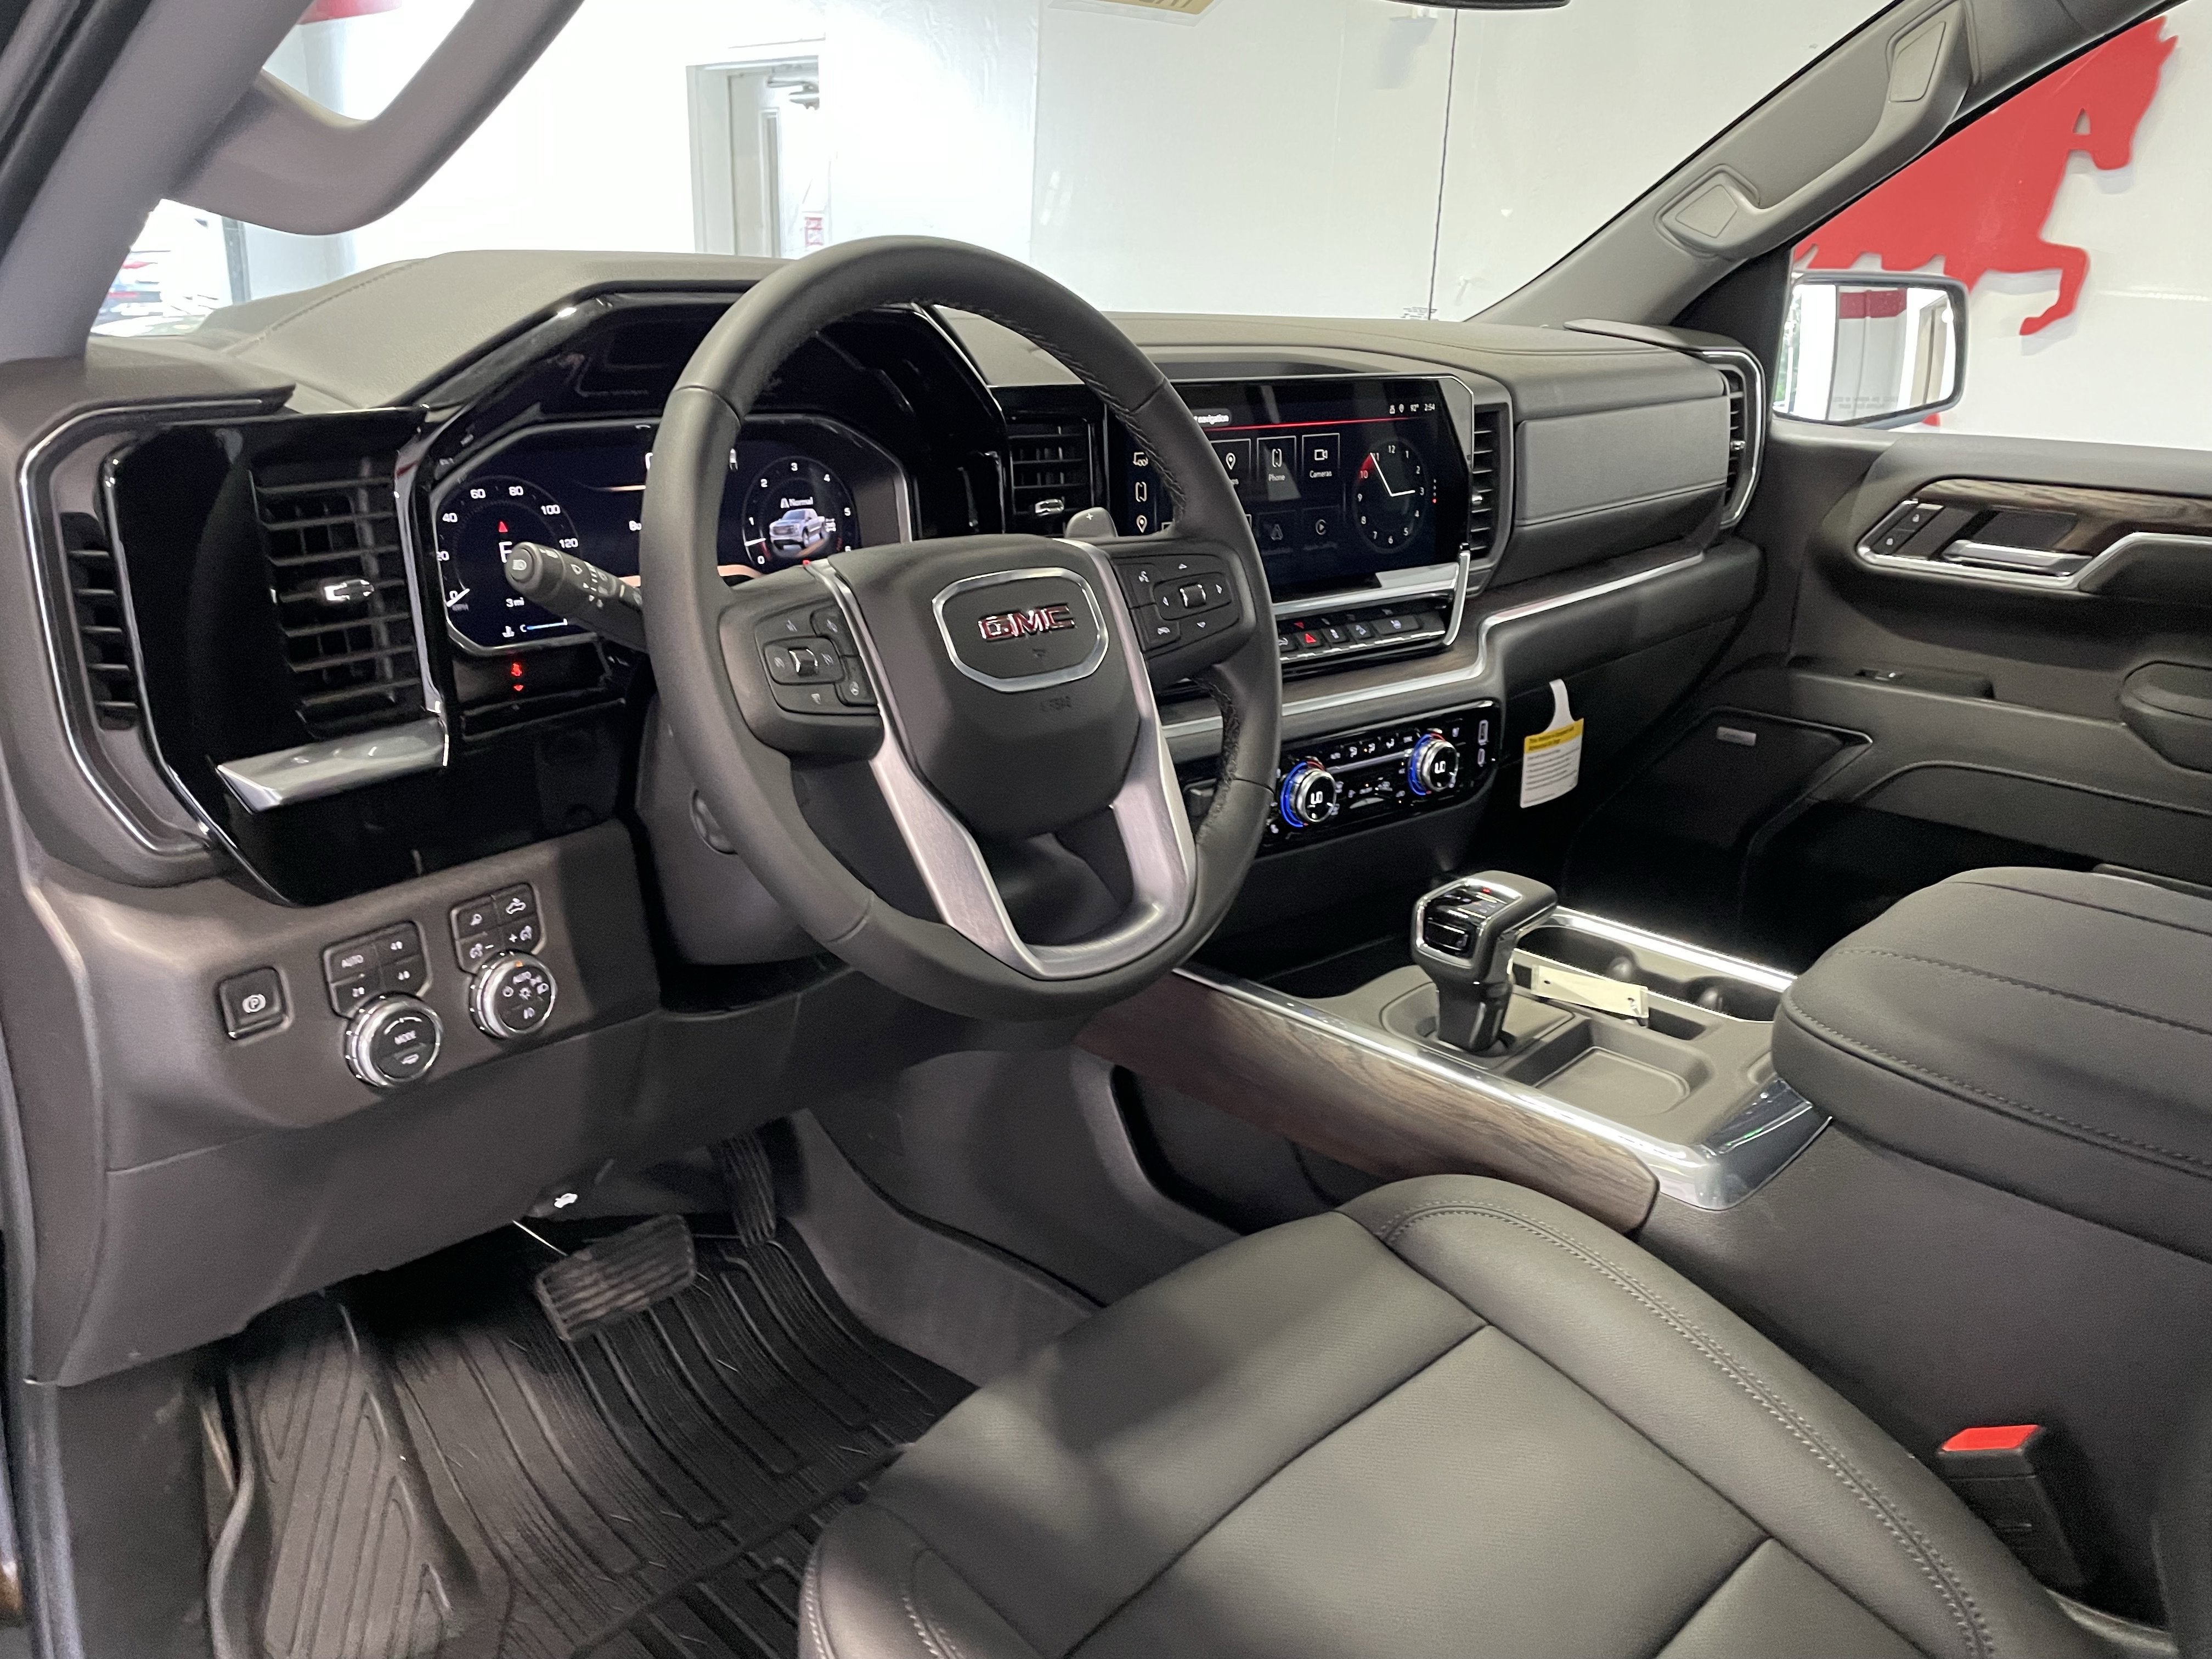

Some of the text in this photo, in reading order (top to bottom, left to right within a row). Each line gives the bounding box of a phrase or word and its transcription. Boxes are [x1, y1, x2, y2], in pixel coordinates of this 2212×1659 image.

[1388, 445, 1396, 454] 12
[1405, 450, 1409, 459] 1
[791, 462, 798, 471] 3
[1415, 466, 1420, 475] 2
[823, 474, 830, 482] 4
[1268, 473, 1285, 482] Phone
[1310, 470, 1333, 478] Cameras
[1360, 470, 1369, 479] 10
[760, 478, 768, 488] 2
[470, 488, 486, 499] 60
[509, 486, 524, 496] 80
[1420, 487, 1425, 496] 3
[1357, 493, 1363, 502] 9
[540, 504, 561, 515] 100
[844, 507, 851, 516] 5
[1414, 510, 1420, 518] 4
[442, 512, 458, 522] 40
[748, 517, 754, 526] 1
[1361, 516, 1367, 524] 8
[1373, 531, 1378, 540] 7
[1403, 527, 1408, 536] 5
[558, 538, 579, 549] 120
[1388, 535, 1393, 544] 6
[757, 555, 765, 565] 0
[978, 605, 1075, 639] GMC
